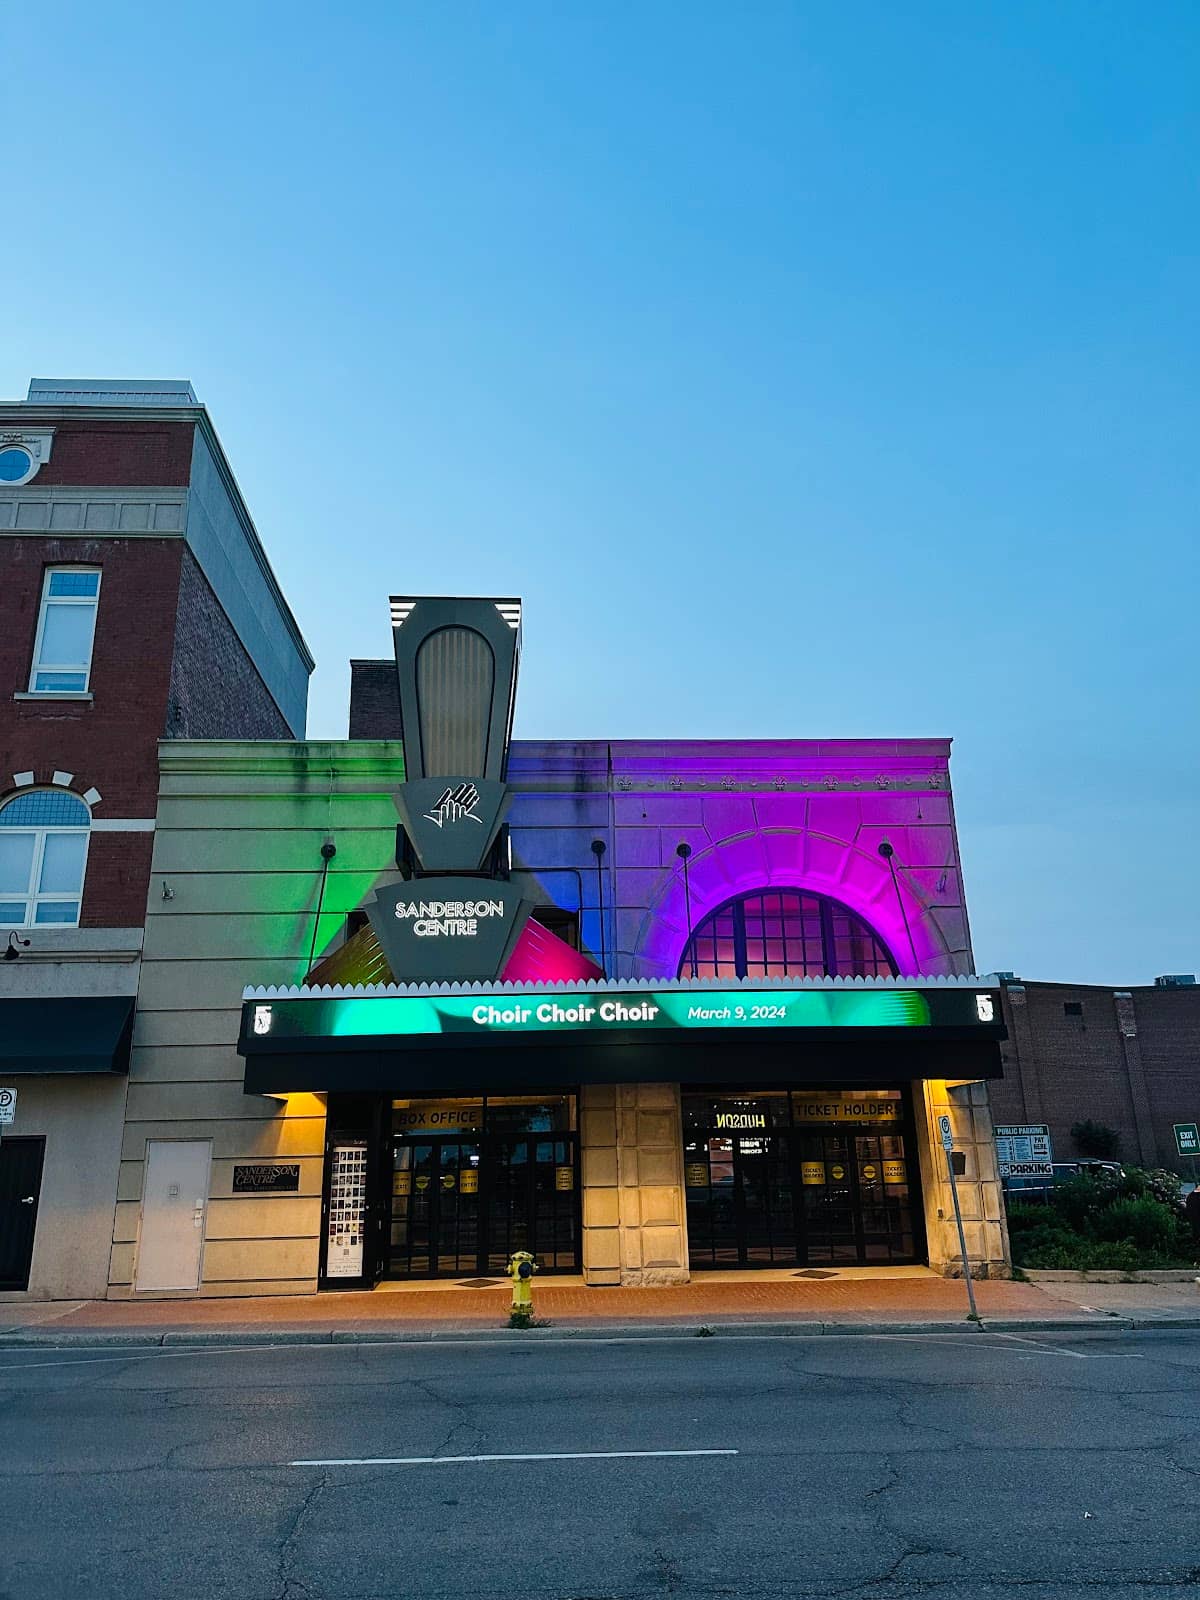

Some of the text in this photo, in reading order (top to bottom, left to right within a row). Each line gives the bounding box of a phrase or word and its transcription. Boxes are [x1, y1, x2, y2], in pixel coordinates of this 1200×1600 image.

[394, 900, 505, 919] SANDERSON
[413, 918, 479, 937] CENTRE
[471, 1001, 660, 1025] Choir Choir Choir
[687, 1005, 787, 1021] March 9, 2024
[796, 1103, 900, 1116] TICKET HOLDERS
[400, 1110, 477, 1125] BOX OFFICE
[997, 1127, 1044, 1136] PUBLIC PARKING
[1180, 1131, 1193, 1140] EXIT
[1034, 1136, 1045, 1144] PAY
[1180, 1139, 1196, 1148] ONLY
[236, 1166, 298, 1177] SANDERSON
[1010, 1163, 1052, 1174] PARKING
[235, 1174, 276, 1186] CENTRE
